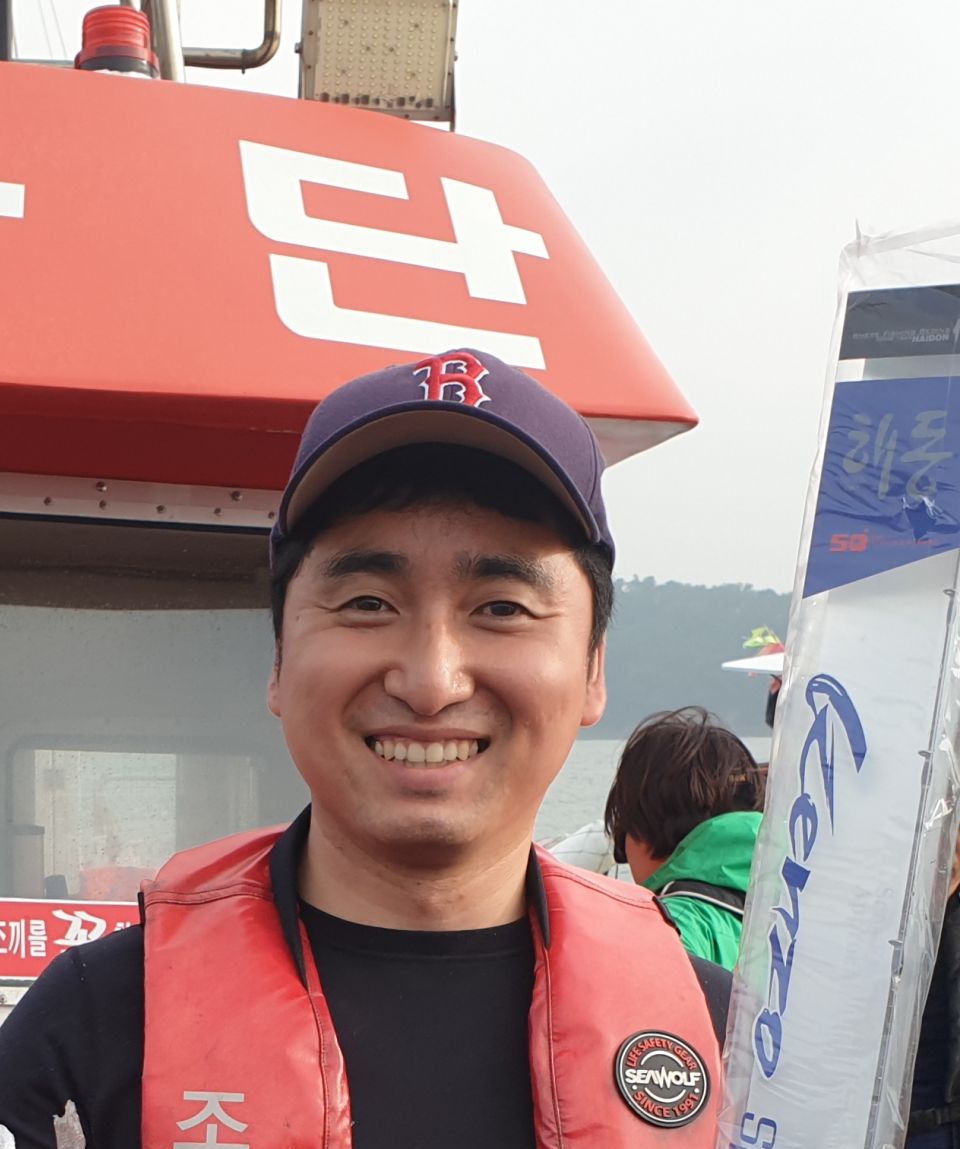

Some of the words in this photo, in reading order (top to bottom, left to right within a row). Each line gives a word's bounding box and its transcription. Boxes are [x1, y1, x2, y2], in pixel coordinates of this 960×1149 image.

[413, 352, 492, 408] B
[843, 409, 953, 507] 해동
[638, 1038, 673, 1051] SAFETY
[674, 1045, 697, 1070] GEAR
[625, 1066, 701, 1089] SEAWOLF
[634, 1091, 672, 1118] SINCE
[673, 1092, 699, 1117] 1991
